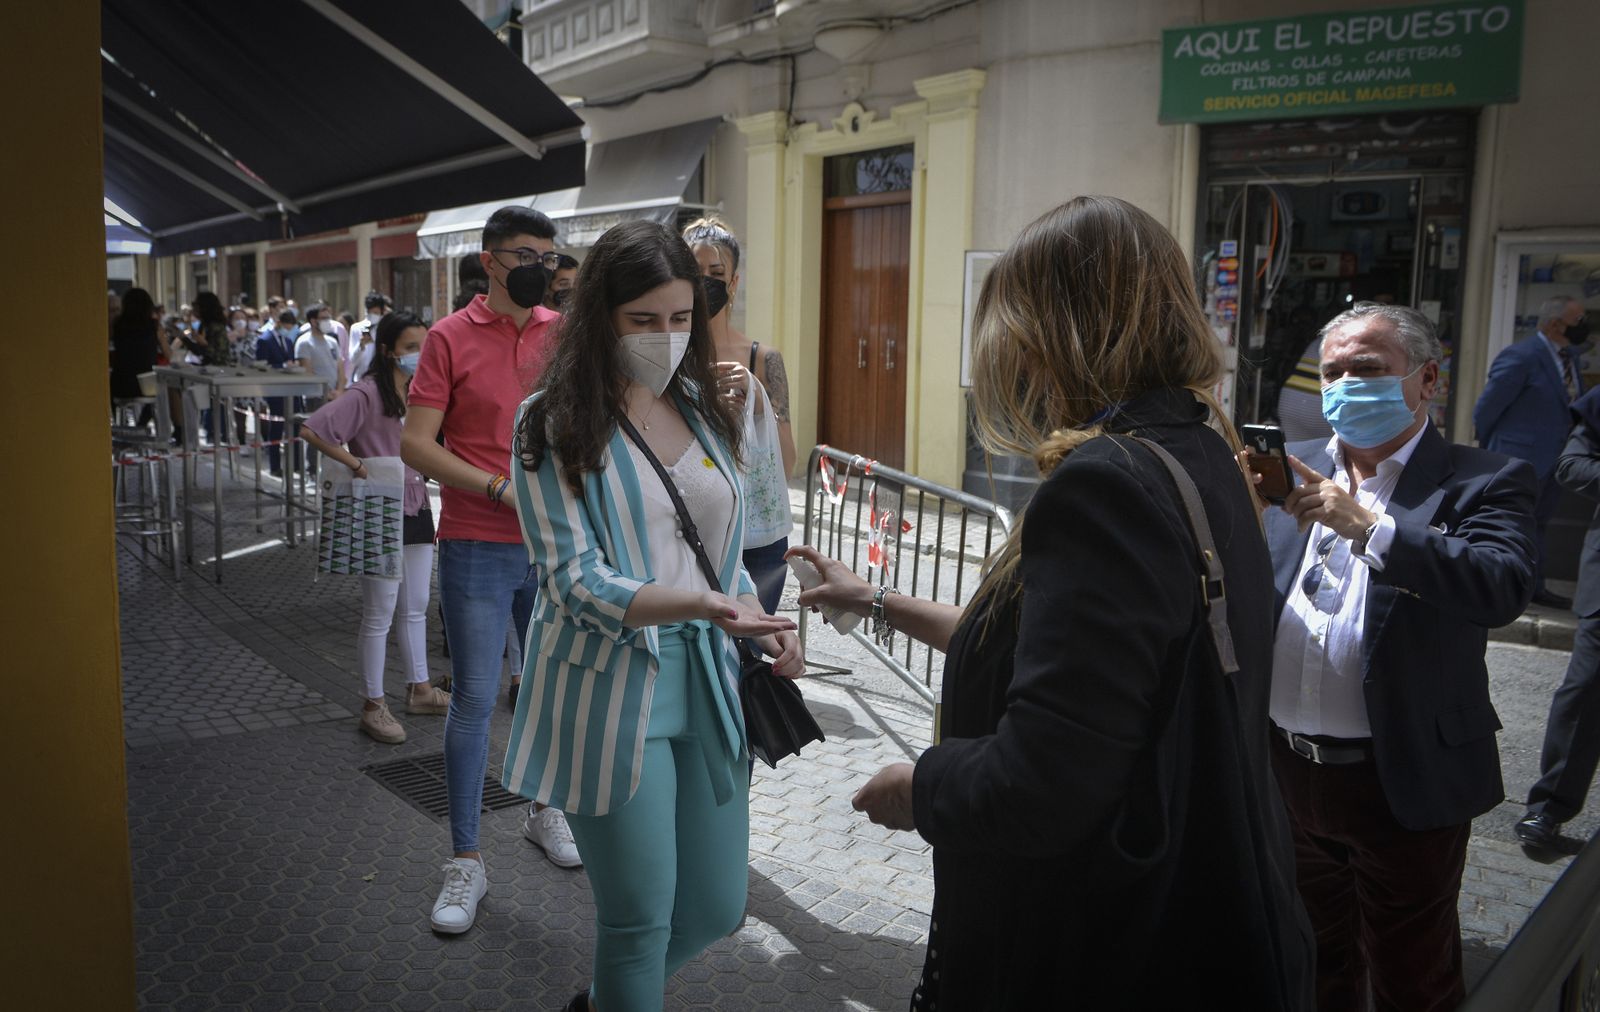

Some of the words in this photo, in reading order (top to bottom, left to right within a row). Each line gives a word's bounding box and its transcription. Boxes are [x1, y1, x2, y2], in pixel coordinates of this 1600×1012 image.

[1174, 28, 1261, 60] AQUI
[1275, 23, 1312, 51] EL
[1326, 5, 1510, 46] REPUESTO
[1200, 59, 1271, 76] COCINAS
[1291, 54, 1343, 70] OLLAS
[1365, 44, 1462, 64] CAFETERAS
[1232, 73, 1300, 91] FILTROS
[1306, 72, 1327, 86] DE
[1332, 66, 1412, 84] CAMPANA
[1203, 92, 1280, 112] SERVICIO
[1283, 89, 1351, 107] OFICIAL
[1355, 81, 1457, 102] MAGEFESA
[851, 116, 859, 133] 6
